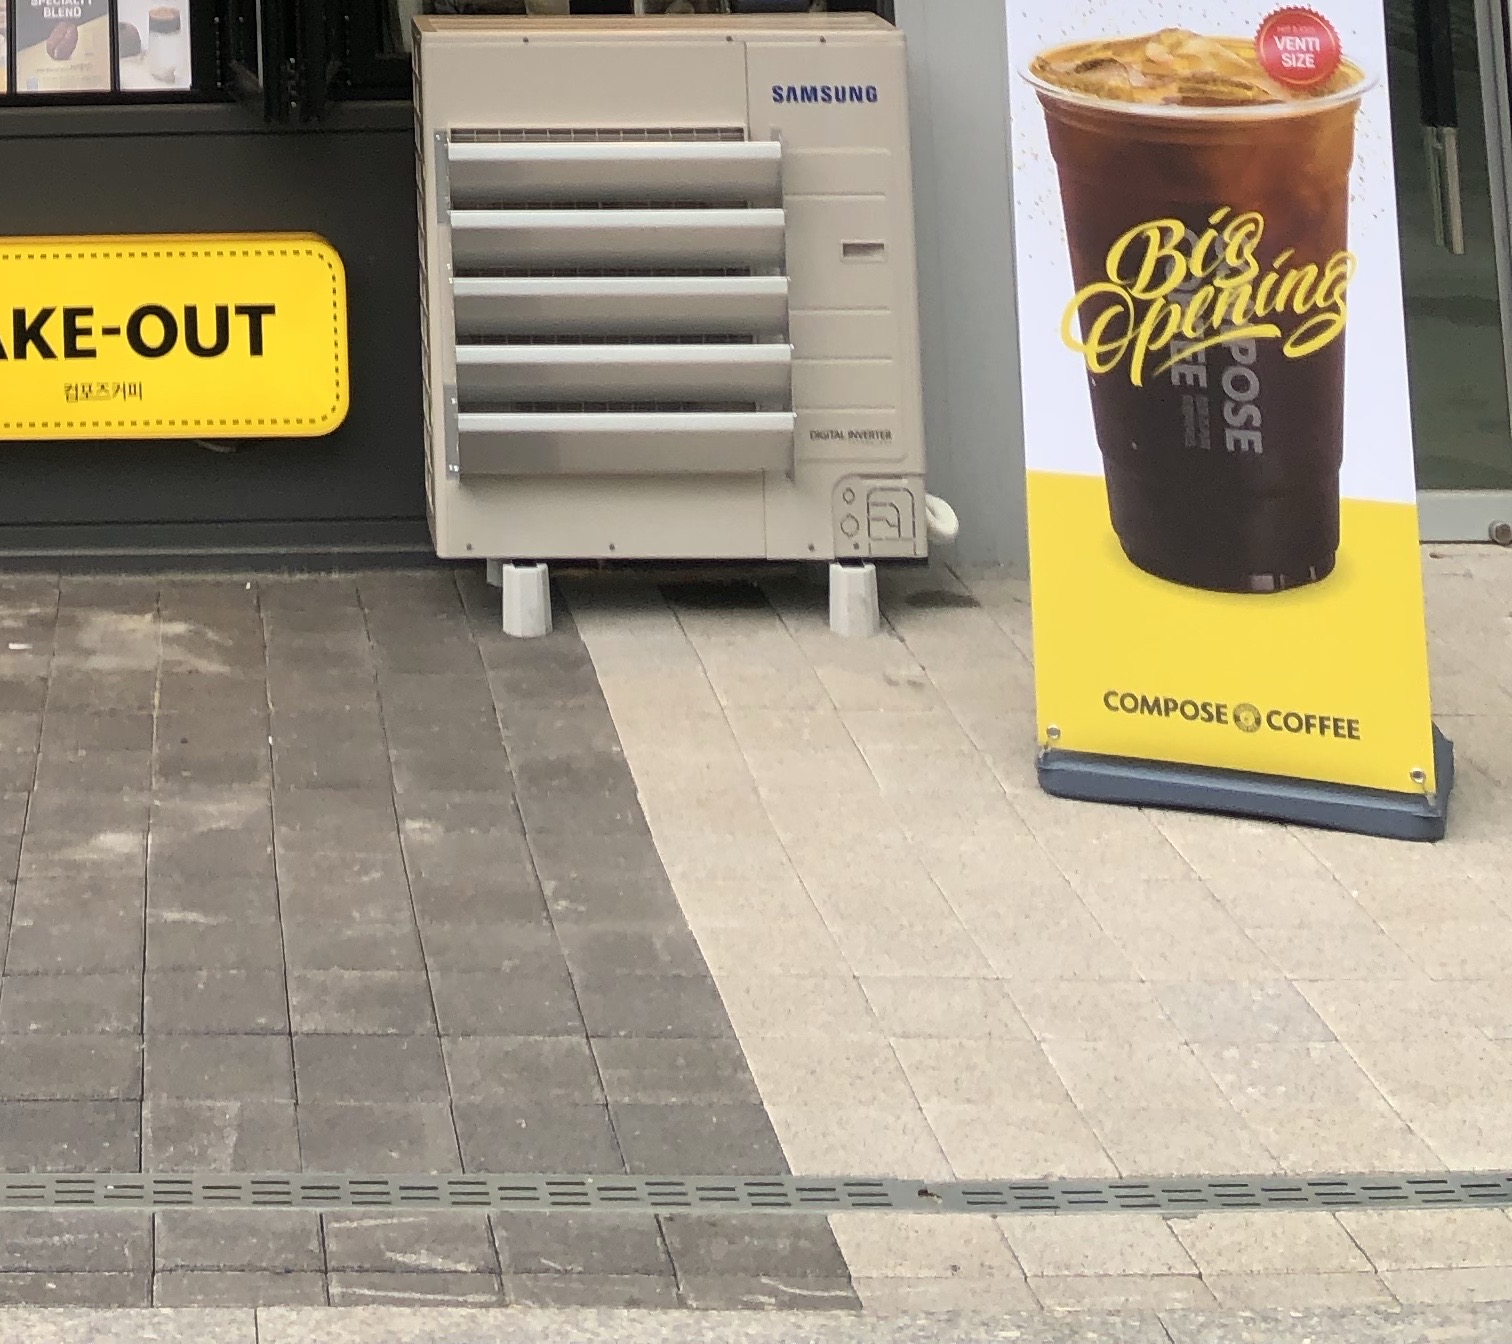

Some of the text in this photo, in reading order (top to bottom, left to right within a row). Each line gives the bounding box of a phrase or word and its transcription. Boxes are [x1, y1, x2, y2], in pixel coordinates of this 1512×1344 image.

[43, 6, 82, 18] BLEND
[1272, 35, 1321, 52] VENTI
[1281, 53, 1316, 68] SIZE
[772, 84, 878, 104] SAMSUNG
[1105, 206, 1266, 299] Big
[1060, 249, 1357, 388] Opening
[64, 381, 143, 403] 컴포즈커피
[809, 430, 893, 440] DIGITAL INVERTER
[1103, 690, 1228, 725] COMPOSE
[1266, 709, 1361, 740] COFFEE
